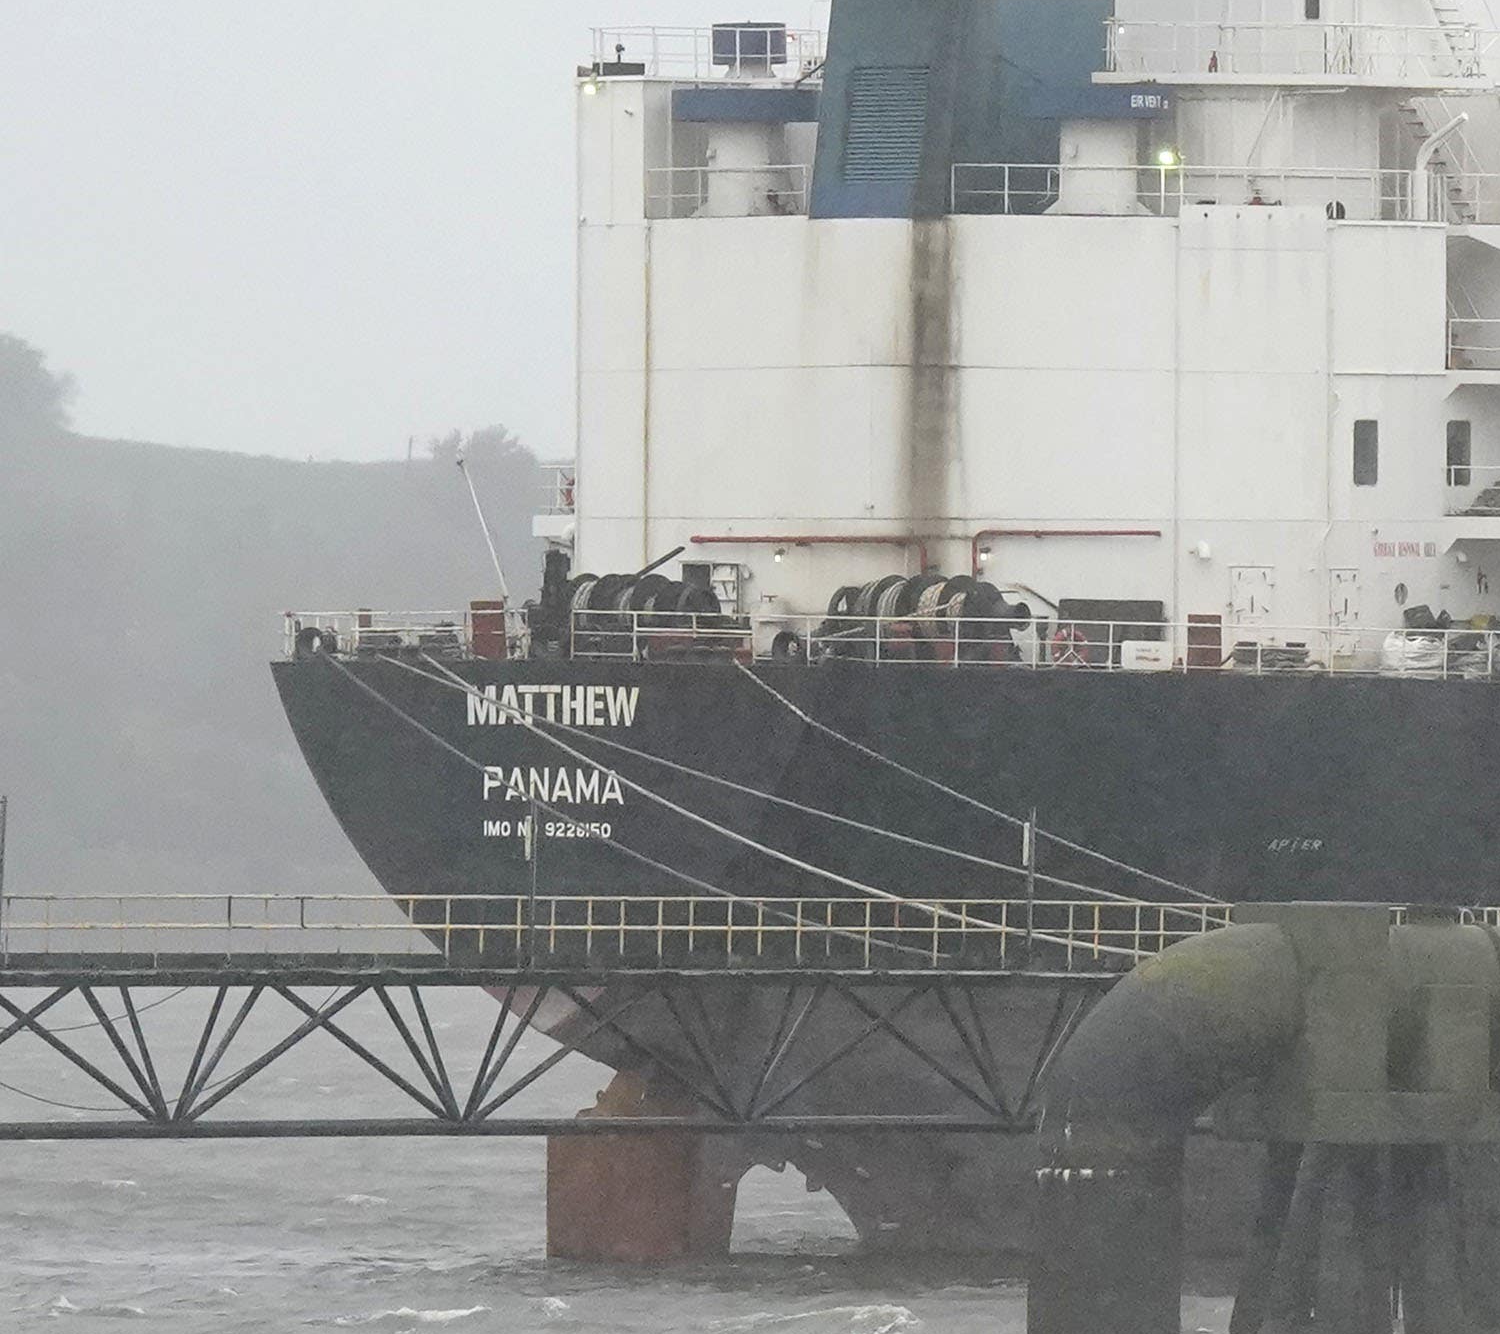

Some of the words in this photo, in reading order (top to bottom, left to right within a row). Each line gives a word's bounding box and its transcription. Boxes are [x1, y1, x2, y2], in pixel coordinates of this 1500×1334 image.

[466, 684, 639, 727] MATTHEW
[483, 766, 624, 805] PANAMA
[483, 820, 511, 837] IMO
